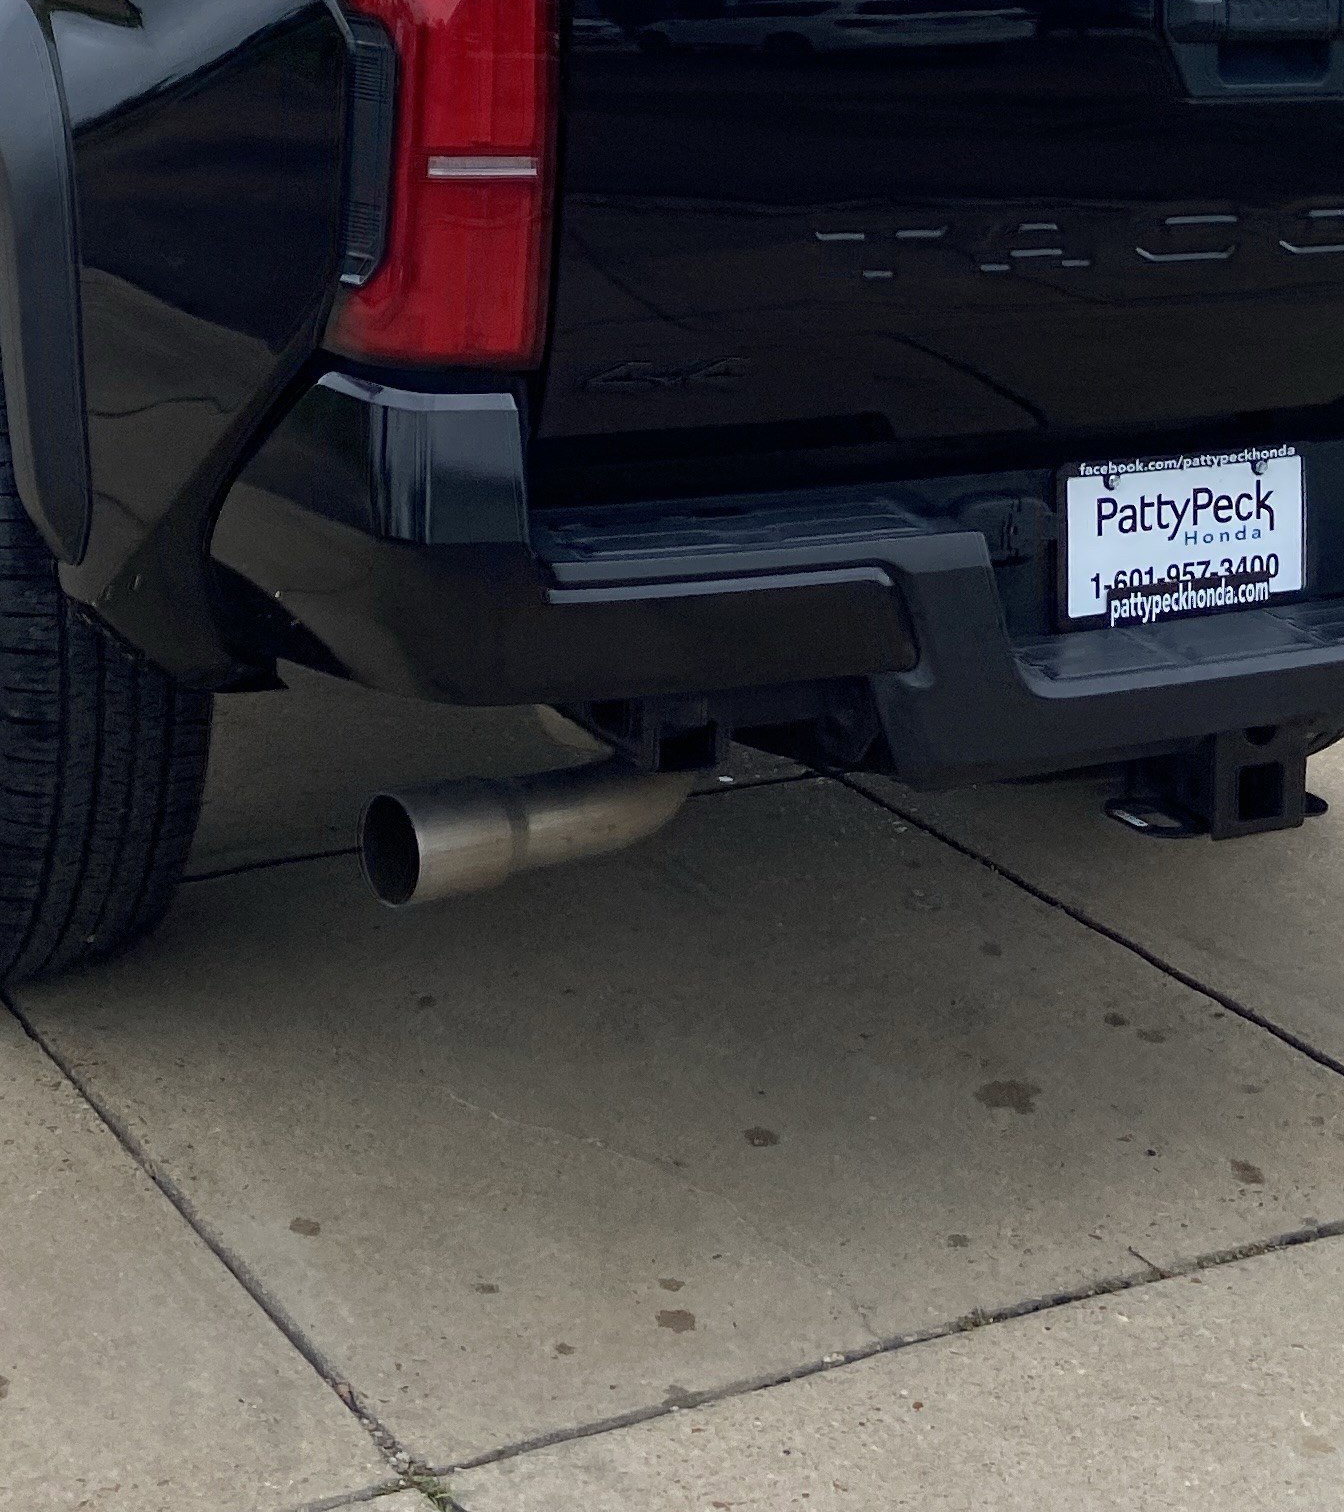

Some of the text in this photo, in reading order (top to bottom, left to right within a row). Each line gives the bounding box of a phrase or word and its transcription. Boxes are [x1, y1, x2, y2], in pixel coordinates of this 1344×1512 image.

[1078, 444, 1296, 477] facebook.com/pattypeckhonda
[1184, 524, 1262, 546] Honda
[1110, 577, 1270, 627] pattypeckhonda.com
